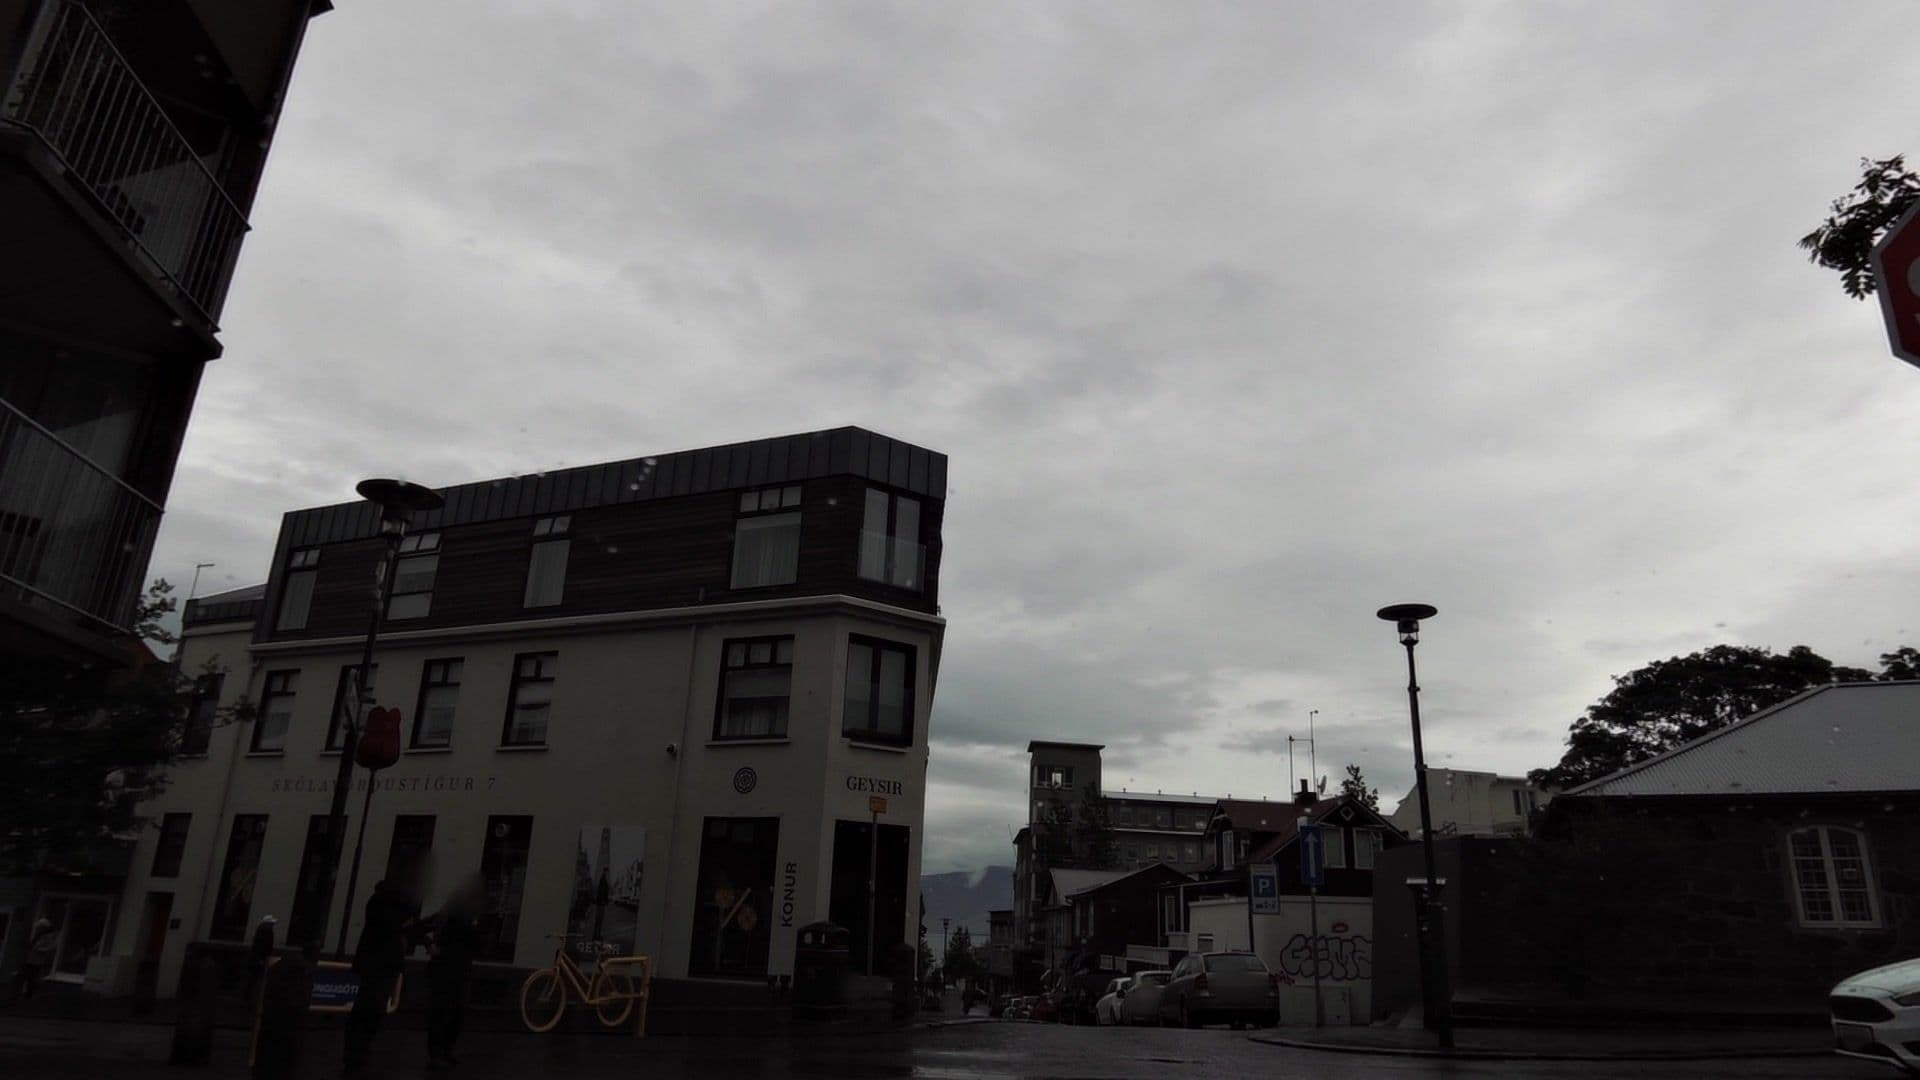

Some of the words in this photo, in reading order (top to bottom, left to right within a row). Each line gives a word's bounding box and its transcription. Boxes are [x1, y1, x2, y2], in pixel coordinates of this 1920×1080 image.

[272, 775, 474, 793] SKÓLARUSTÍGUR
[487, 777, 497, 791] 7
[846, 776, 903, 796] GEYSIR
[781, 861, 797, 928] KONUR
[1258, 878, 1270, 895] P
